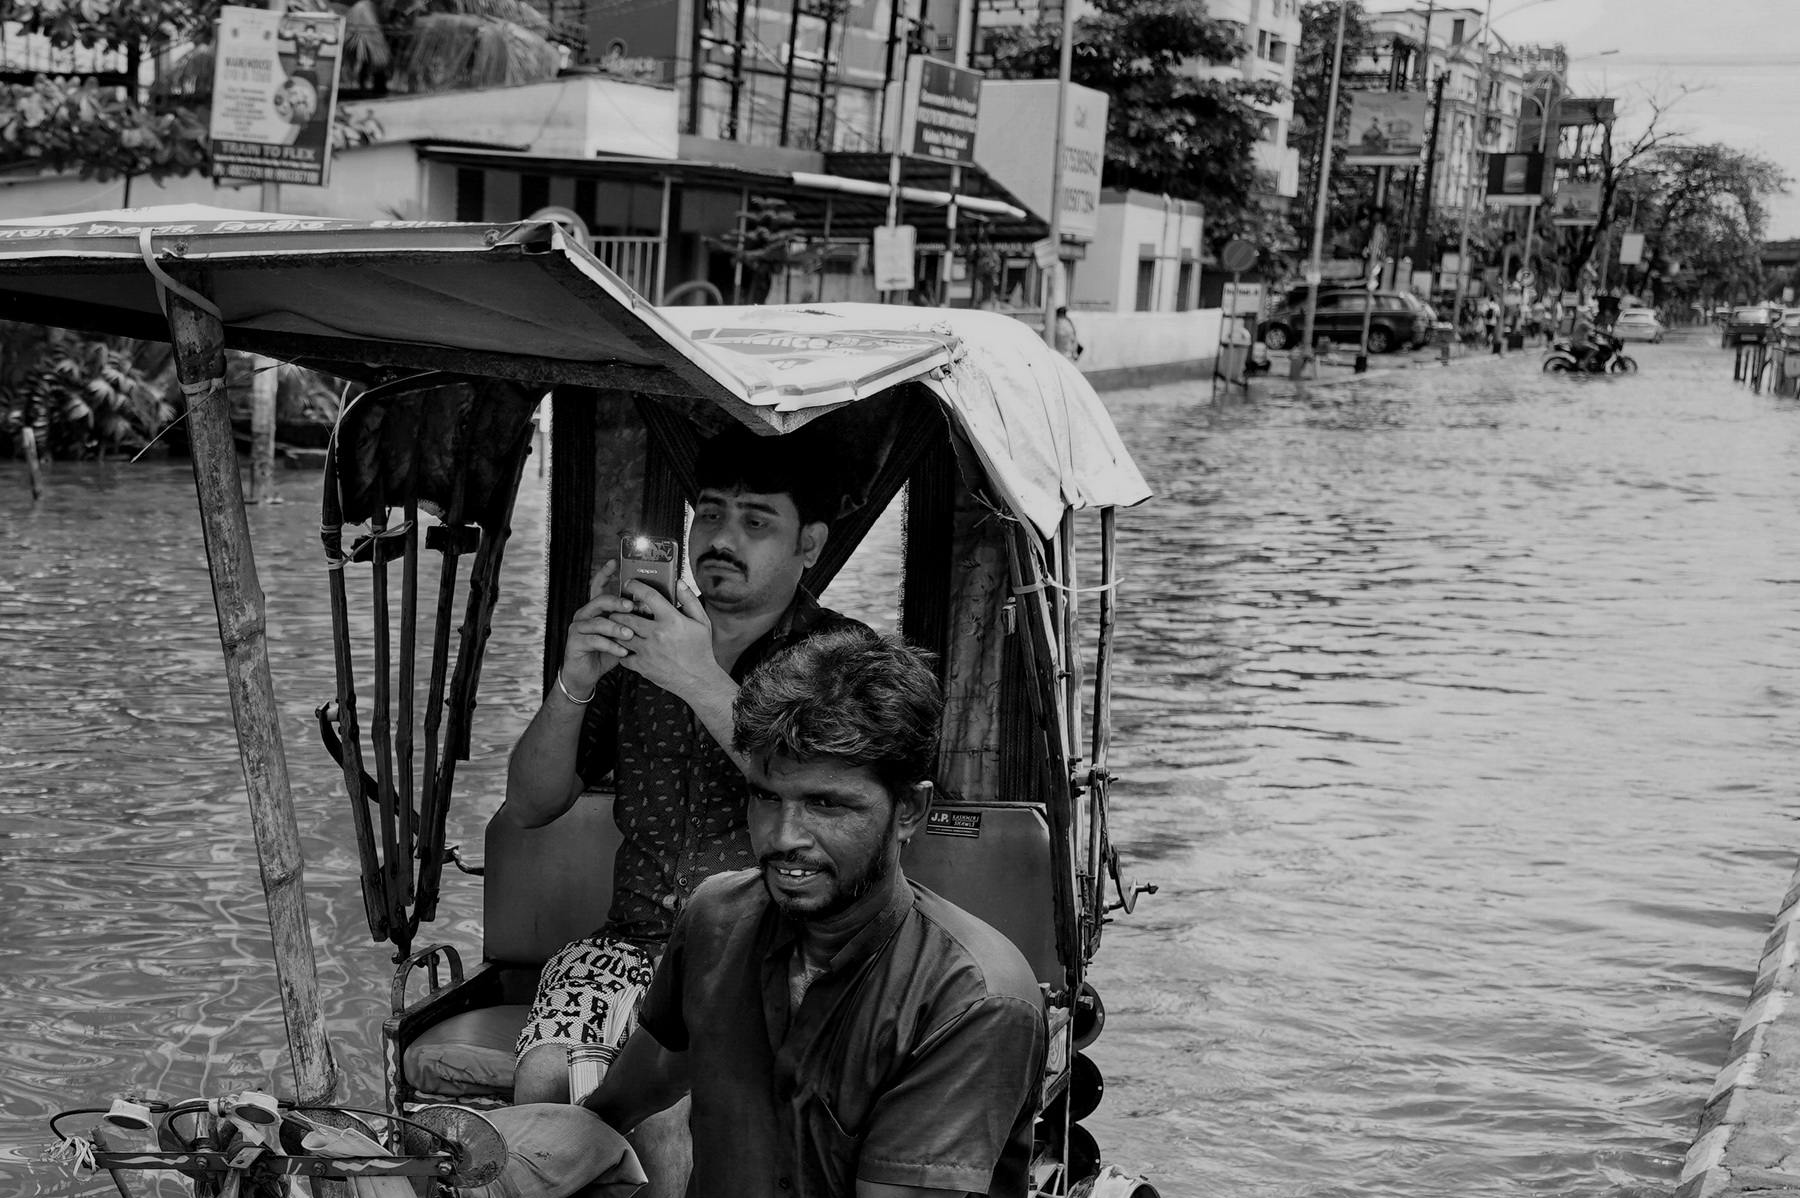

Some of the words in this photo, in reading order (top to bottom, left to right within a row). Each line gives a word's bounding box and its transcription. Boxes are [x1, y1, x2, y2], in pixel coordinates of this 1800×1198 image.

[221, 141, 262, 156] TRAIN
[263, 145, 281, 159] TO
[282, 146, 316, 161] FLEX
[930, 812, 949, 823] J.P.
